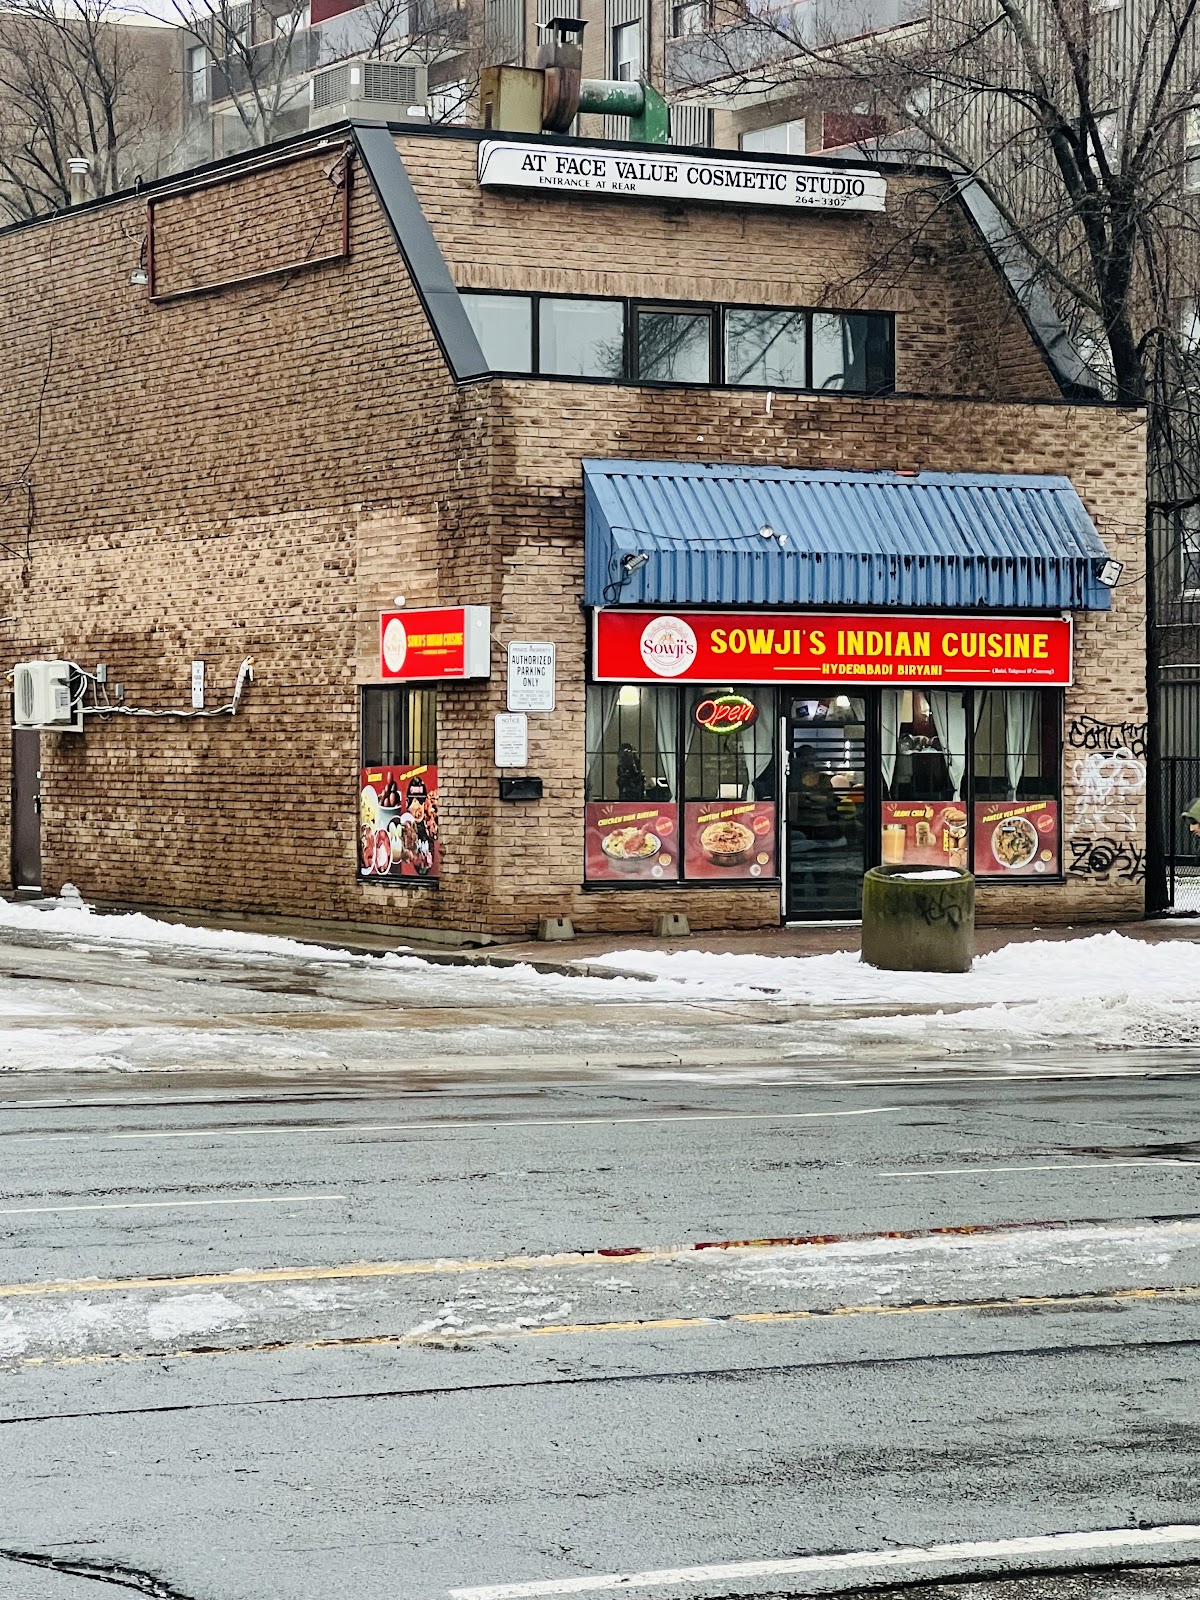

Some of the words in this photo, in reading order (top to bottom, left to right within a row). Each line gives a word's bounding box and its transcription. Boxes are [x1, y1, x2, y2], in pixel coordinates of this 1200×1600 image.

[521, 154, 547, 172] AT
[555, 156, 606, 177] FACE
[615, 161, 678, 183] VALUE
[686, 167, 787, 191] COSMETIC
[795, 176, 865, 196] STUDIO
[539, 176, 590, 188] ENTRANCE
[595, 181, 607, 189] AT
[612, 182, 636, 191] REAR
[795, 196, 847, 207] 264-3307
[643, 639, 694, 659] Sowji's
[710, 628, 827, 655] SOWJI'S
[837, 630, 931, 657] INDIAN
[941, 632, 1049, 658] CUISINE
[511, 655, 552, 666] AUTHORIZED
[516, 666, 546, 676] PARKING
[822, 663, 893, 675] HYDERABADI
[897, 664, 943, 676] BIRYANI
[522, 677, 540, 687] ONLY
[695, 699, 755, 726] Open
